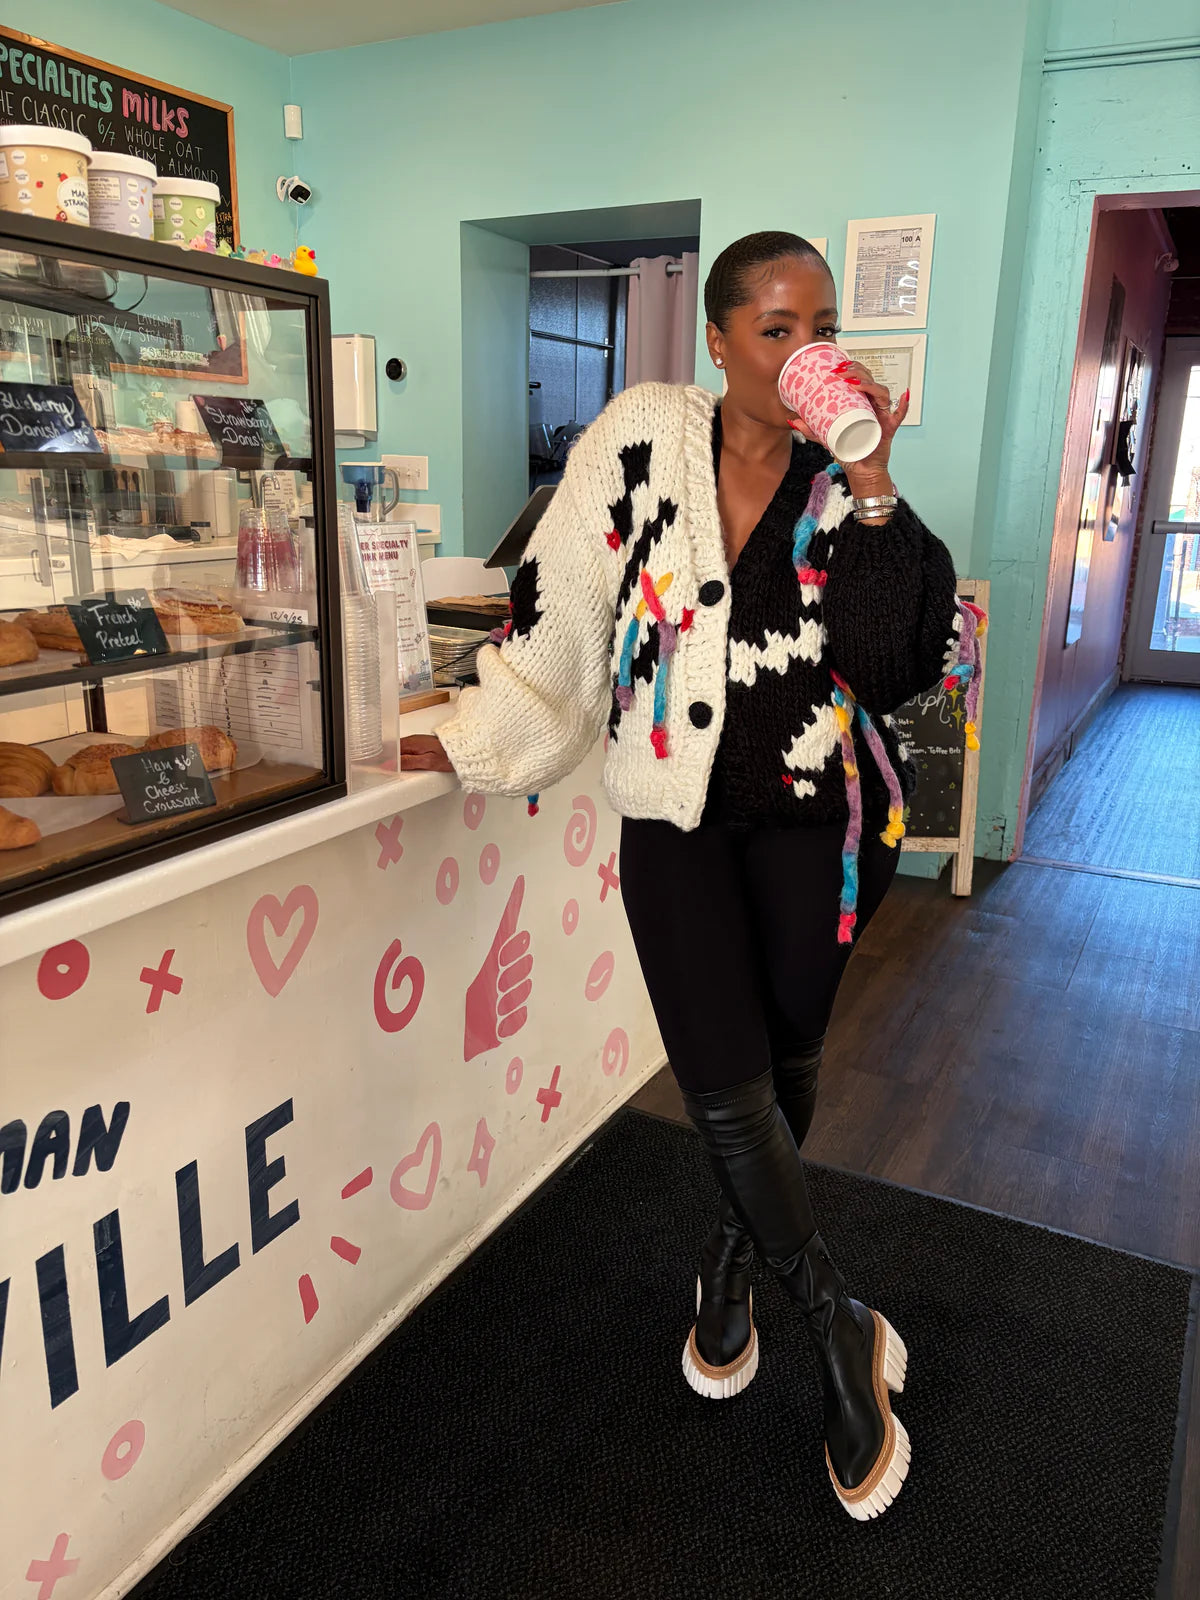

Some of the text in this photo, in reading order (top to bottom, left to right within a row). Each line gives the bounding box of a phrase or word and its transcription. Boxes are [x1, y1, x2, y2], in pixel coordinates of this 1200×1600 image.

[21, 96, 88, 138] CLASSIC
[97, 117, 116, 146] 6/7
[175, 141, 203, 163] OAT
[168, 157, 219, 185] ALMOND
[0, 413, 60, 439] Danish
[204, 404, 273, 435] Strawberry
[222, 426, 265, 449] Danish
[371, 540, 409, 550] SPECIALTY
[379, 551, 399, 560] MENU
[87, 602, 137, 626] French
[95, 627, 144, 649] Pretzel
[927, 746, 948, 755] Toffee
[140, 757, 173, 773] Ham
[145, 782, 189, 800] Cheese
[0, 1097, 300, 1410] ILLE
